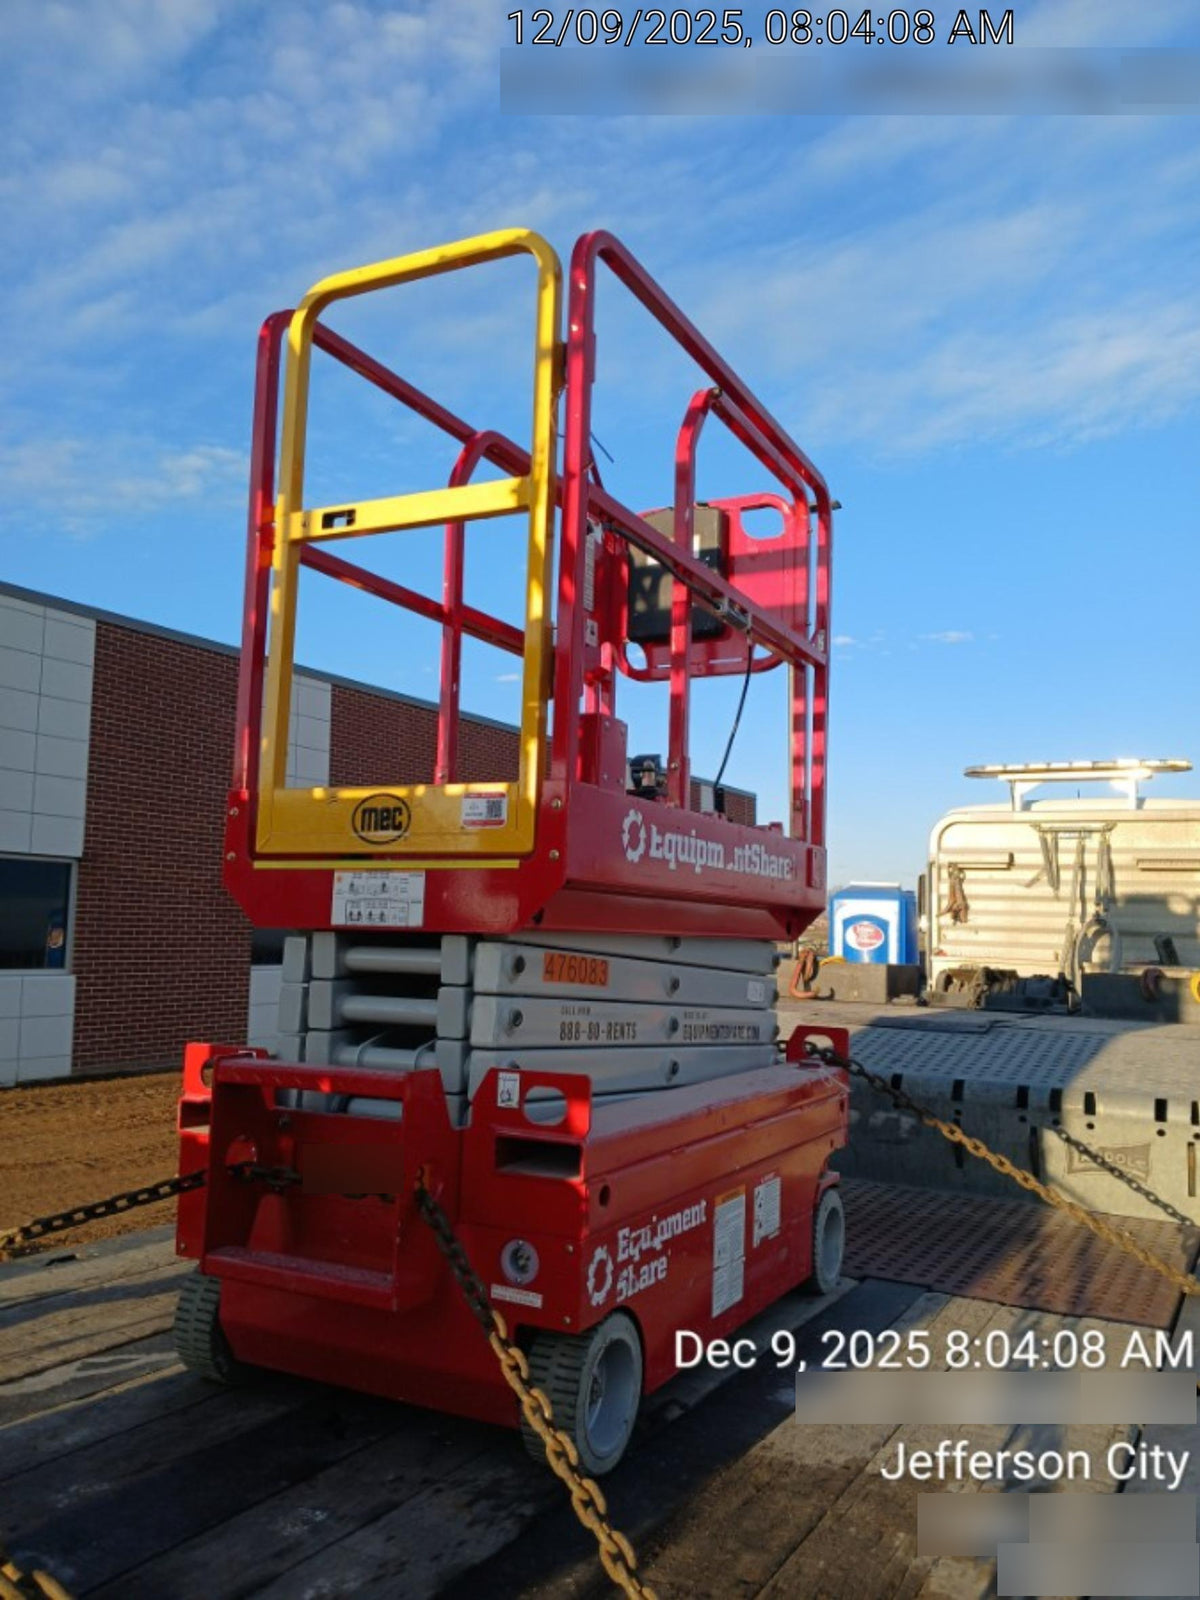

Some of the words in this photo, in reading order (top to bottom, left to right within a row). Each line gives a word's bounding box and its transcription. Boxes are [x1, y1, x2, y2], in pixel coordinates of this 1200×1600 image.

[649, 825, 793, 880] EquipmntShare
[544, 953, 608, 987] 476083
[559, 1021, 637, 1041] 888-80-RENTS
